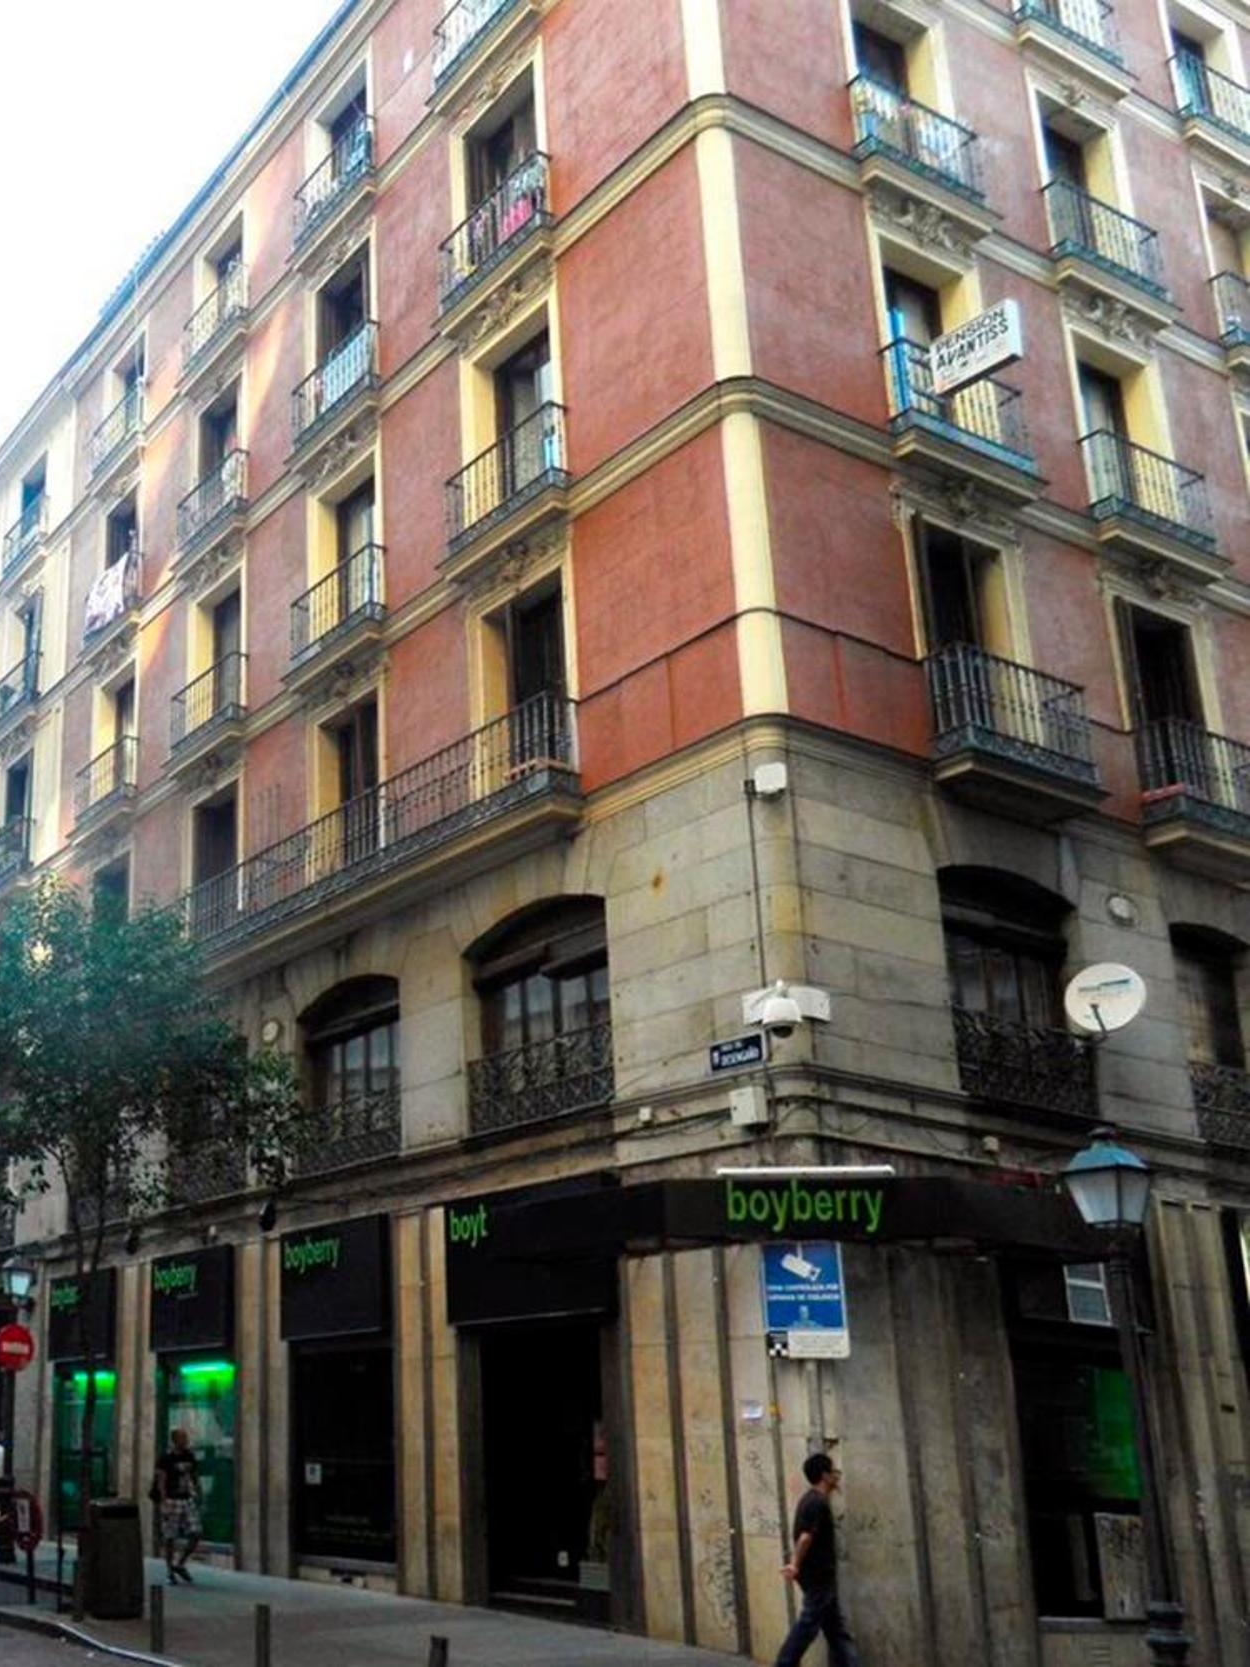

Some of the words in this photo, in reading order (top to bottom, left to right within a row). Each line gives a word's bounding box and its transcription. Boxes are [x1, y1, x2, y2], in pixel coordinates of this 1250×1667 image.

[935, 307, 1005, 354] PENSION
[936, 317, 1009, 370] AVANTISS
[726, 1178, 883, 1232] boyberry
[284, 1235, 340, 1275] boyberry
